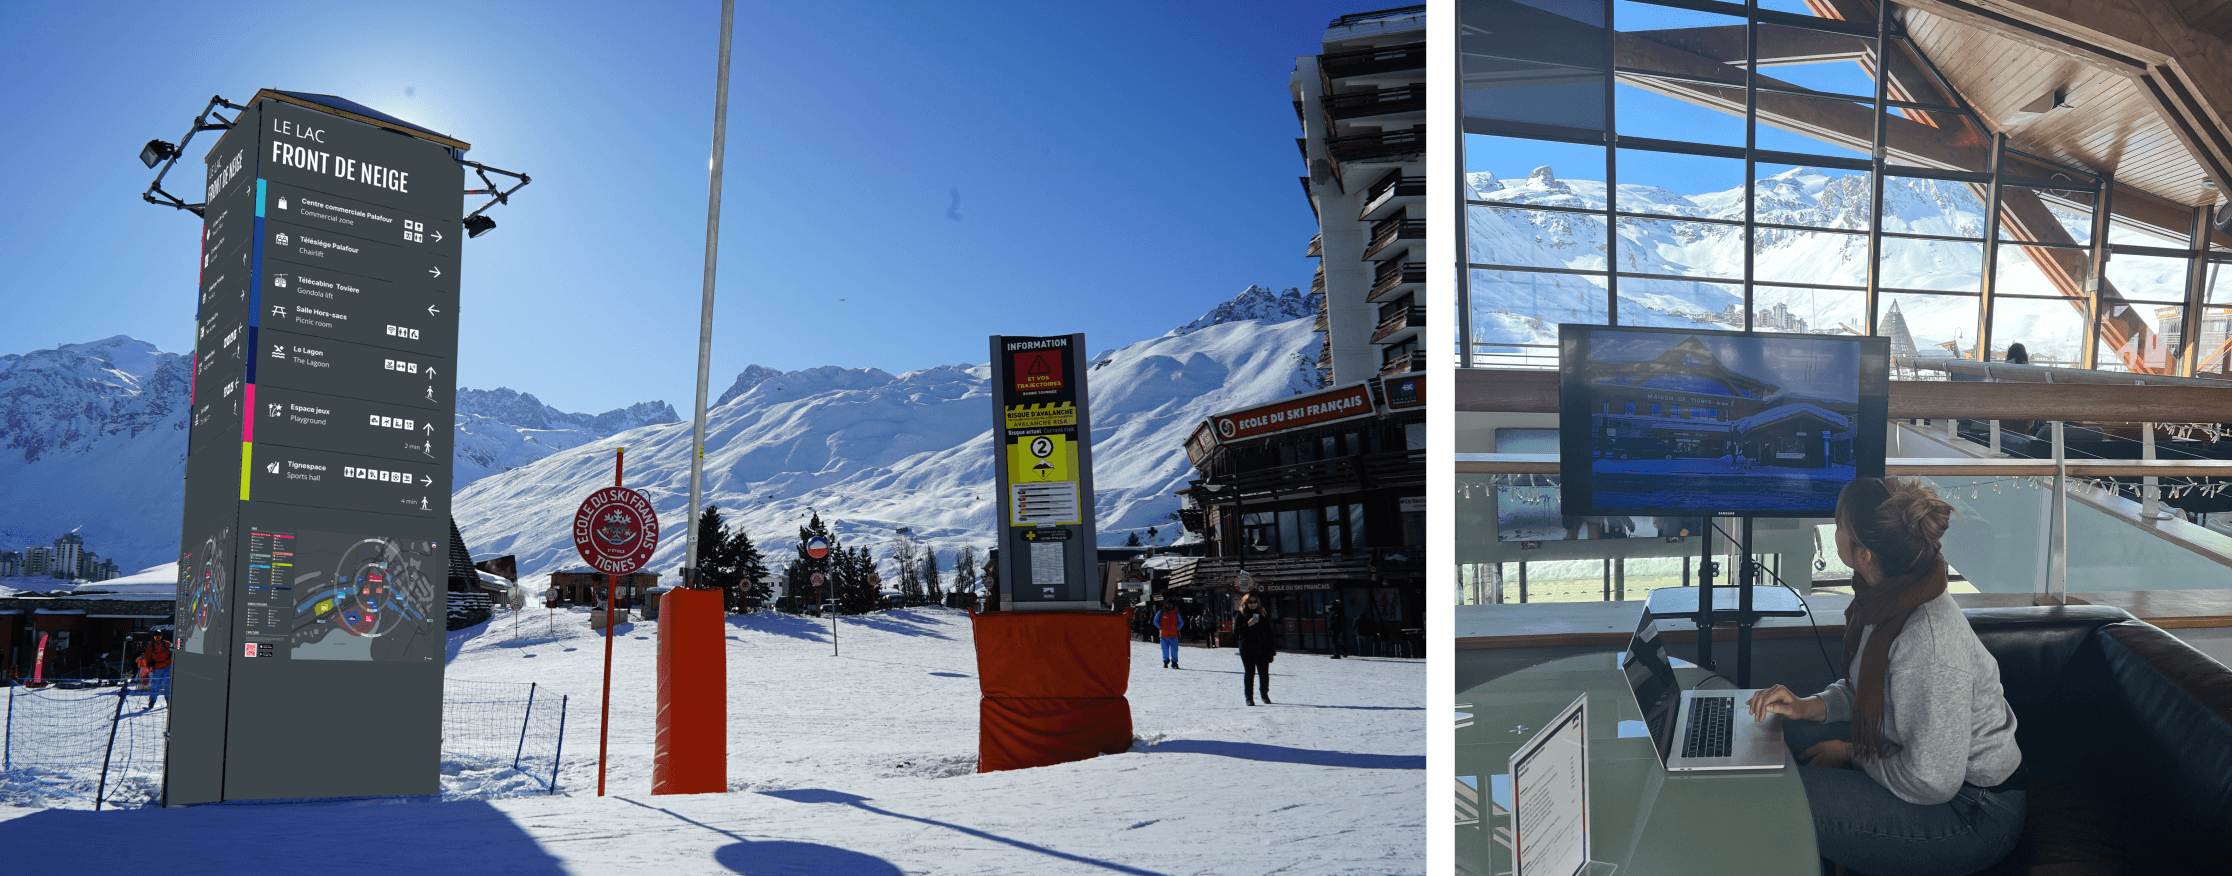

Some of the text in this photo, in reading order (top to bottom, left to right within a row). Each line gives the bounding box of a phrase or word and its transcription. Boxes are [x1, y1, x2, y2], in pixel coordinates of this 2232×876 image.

[273, 118, 326, 143] LE LAC
[272, 140, 409, 194] FRONT DE NEIGE
[300, 209, 354, 226] Commercial zone
[301, 198, 393, 224] Centre commerciale Palafour
[299, 247, 324, 258] Chairlift
[332, 242, 359, 254] Palafour
[298, 276, 360, 294] Télécabine Tovière
[297, 287, 334, 300] Gondola lift
[296, 306, 348, 320] Salle Hors-sacs
[295, 317, 333, 329] Picnic room
[293, 345, 324, 356] Le Lagon
[1007, 338, 1067, 351] INFORMATION
[293, 357, 330, 369] The Lagoon
[1017, 381, 1062, 389] TRAJECTOIRES
[290, 403, 330, 416] Espace jeux
[1031, 409, 1074, 418] D'AVALANCHE
[1239, 395, 1363, 430] ECOLE DU SKI FRANÇAIS
[290, 415, 327, 426] Playground
[1037, 440, 1047, 454] 2
[287, 460, 327, 473] Tignespace
[286, 471, 321, 482] Sports hall
[576, 490, 656, 550] ECOLE DU SKI FRANÇAIS
[594, 555, 636, 572] TIGNES
